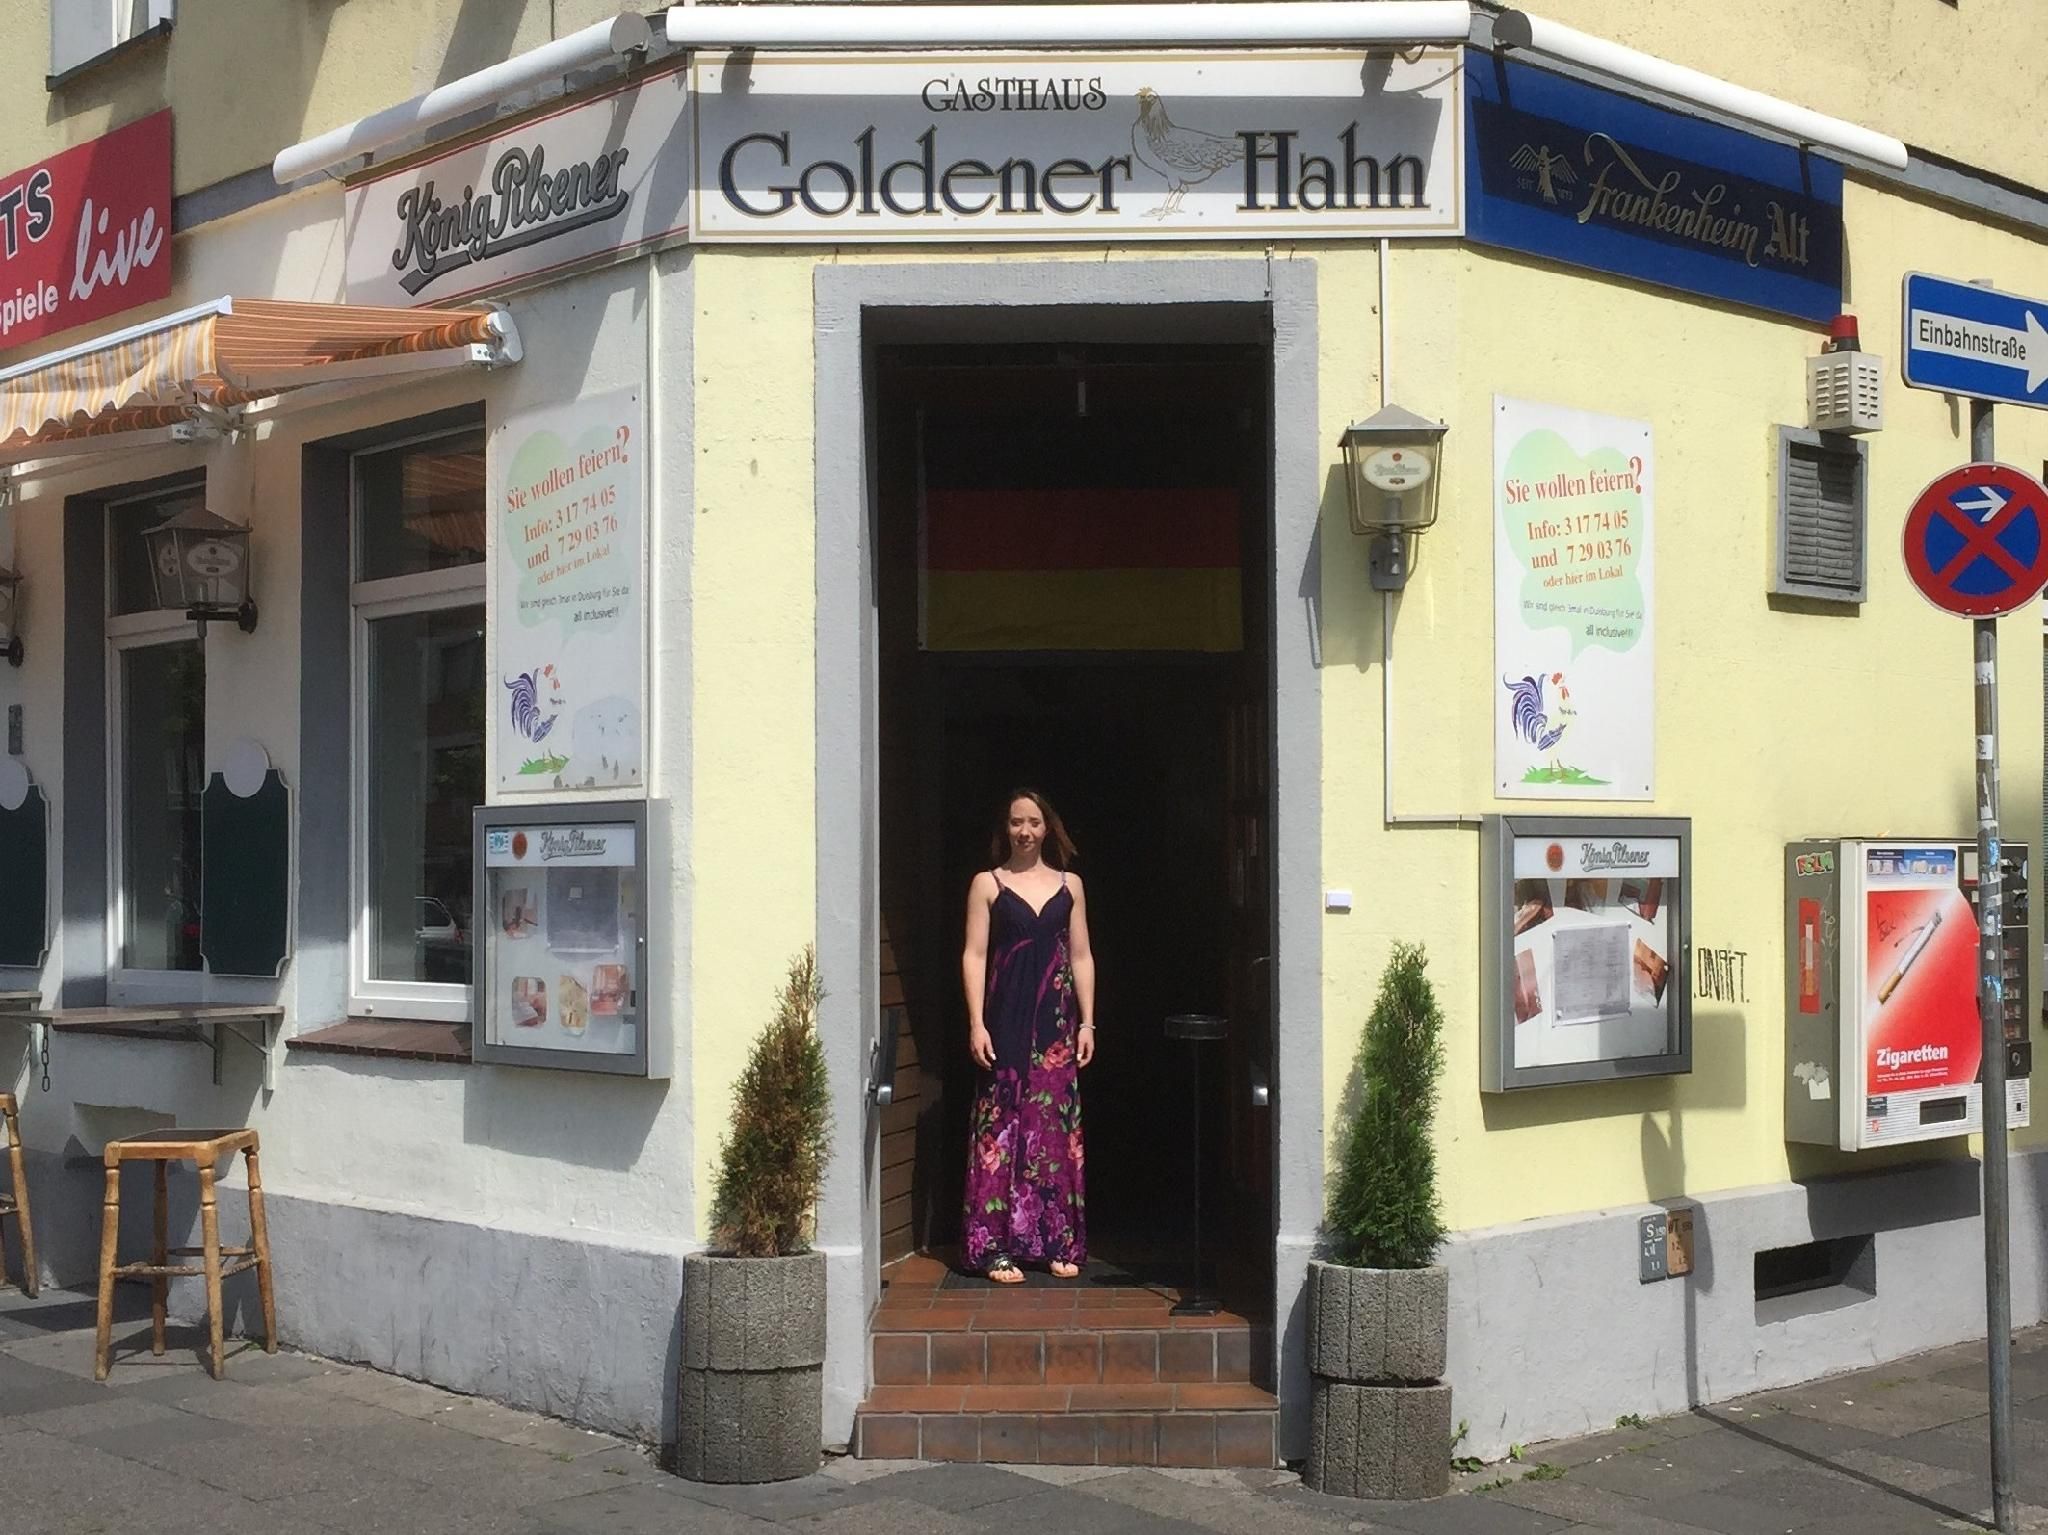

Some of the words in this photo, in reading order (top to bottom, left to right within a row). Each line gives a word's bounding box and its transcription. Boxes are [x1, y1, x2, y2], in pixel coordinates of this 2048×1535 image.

[922, 77, 1106, 112] GASTHAUS
[718, 123, 1132, 218] Goldener
[1235, 119, 1431, 213] Hahn
[0, 169, 54, 260] TS
[392, 181, 492, 273] König
[489, 144, 629, 239] Pilsener
[1577, 132, 1759, 267] Frankenheim
[1764, 201, 1809, 266] Alt
[69, 199, 163, 301] live
[0, 280, 58, 335] piele
[1920, 319, 2026, 360] Einbahnstraße
[507, 487, 527, 513] Sie
[531, 465, 574, 501] wollen
[579, 425, 630, 478] feiern?
[1505, 479, 1530, 504] Sie
[1535, 474, 1586, 500] wollen
[1590, 456, 1642, 494] feiern?
[524, 519, 553, 544] Info:
[1528, 519, 1561, 540] Info:
[1565, 516, 1573, 535] 3
[1576, 515, 1590, 534] 17
[1594, 512, 1610, 531] 74
[1614, 510, 1629, 529] 05
[527, 544, 550, 569] und
[1531, 548, 1558, 569] und
[1567, 546, 1575, 563] 7
[1579, 543, 1593, 562] 29
[1597, 540, 1613, 559] 03
[1616, 538, 1632, 556] 76
[537, 568, 554, 585] oder
[1543, 571, 1563, 588] oder
[1565, 569, 1583, 585] hier
[1586, 569, 1596, 582] im
[1599, 565, 1624, 580] Lokal
[1580, 843, 1611, 868] König
[1611, 842, 1649, 864] Pilsener
[1877, 1044, 1949, 1070] Zigaretten
